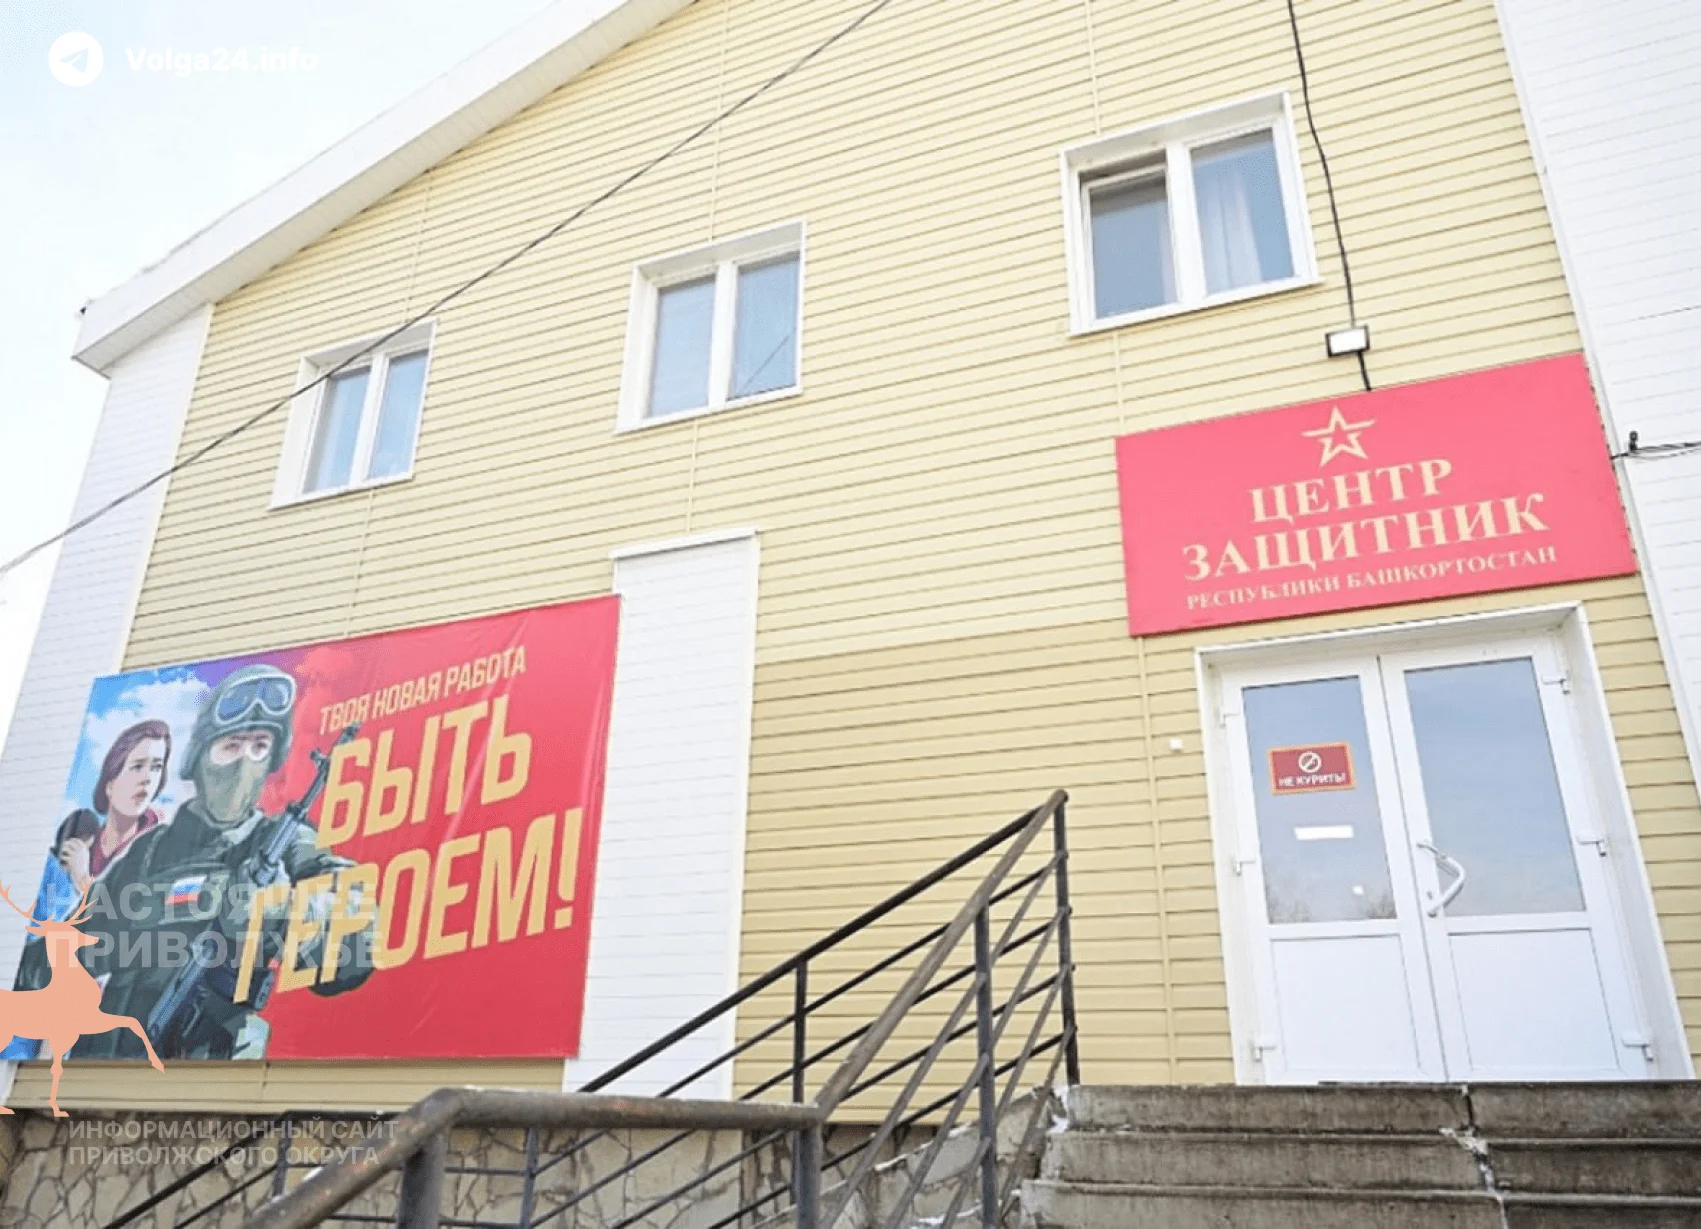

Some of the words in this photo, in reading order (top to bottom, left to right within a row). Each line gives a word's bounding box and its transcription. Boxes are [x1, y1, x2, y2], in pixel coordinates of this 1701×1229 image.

[1247, 458, 1452, 524] ЦЕНТР
[1182, 492, 1550, 581] ЗАЩИТНИК
[1186, 576, 1341, 610] РЕСПУБЛИКИ
[1346, 546, 1557, 589] БАШКОРТОСТАН
[319, 697, 370, 735] ТВОЯ
[372, 673, 440, 719] НОВАЯ
[443, 646, 527, 698] РАБОТА
[315, 694, 533, 849] БЫТЬ
[1278, 777, 1294, 787] НЕ
[233, 807, 583, 1004] ГЕРОЕМ!
